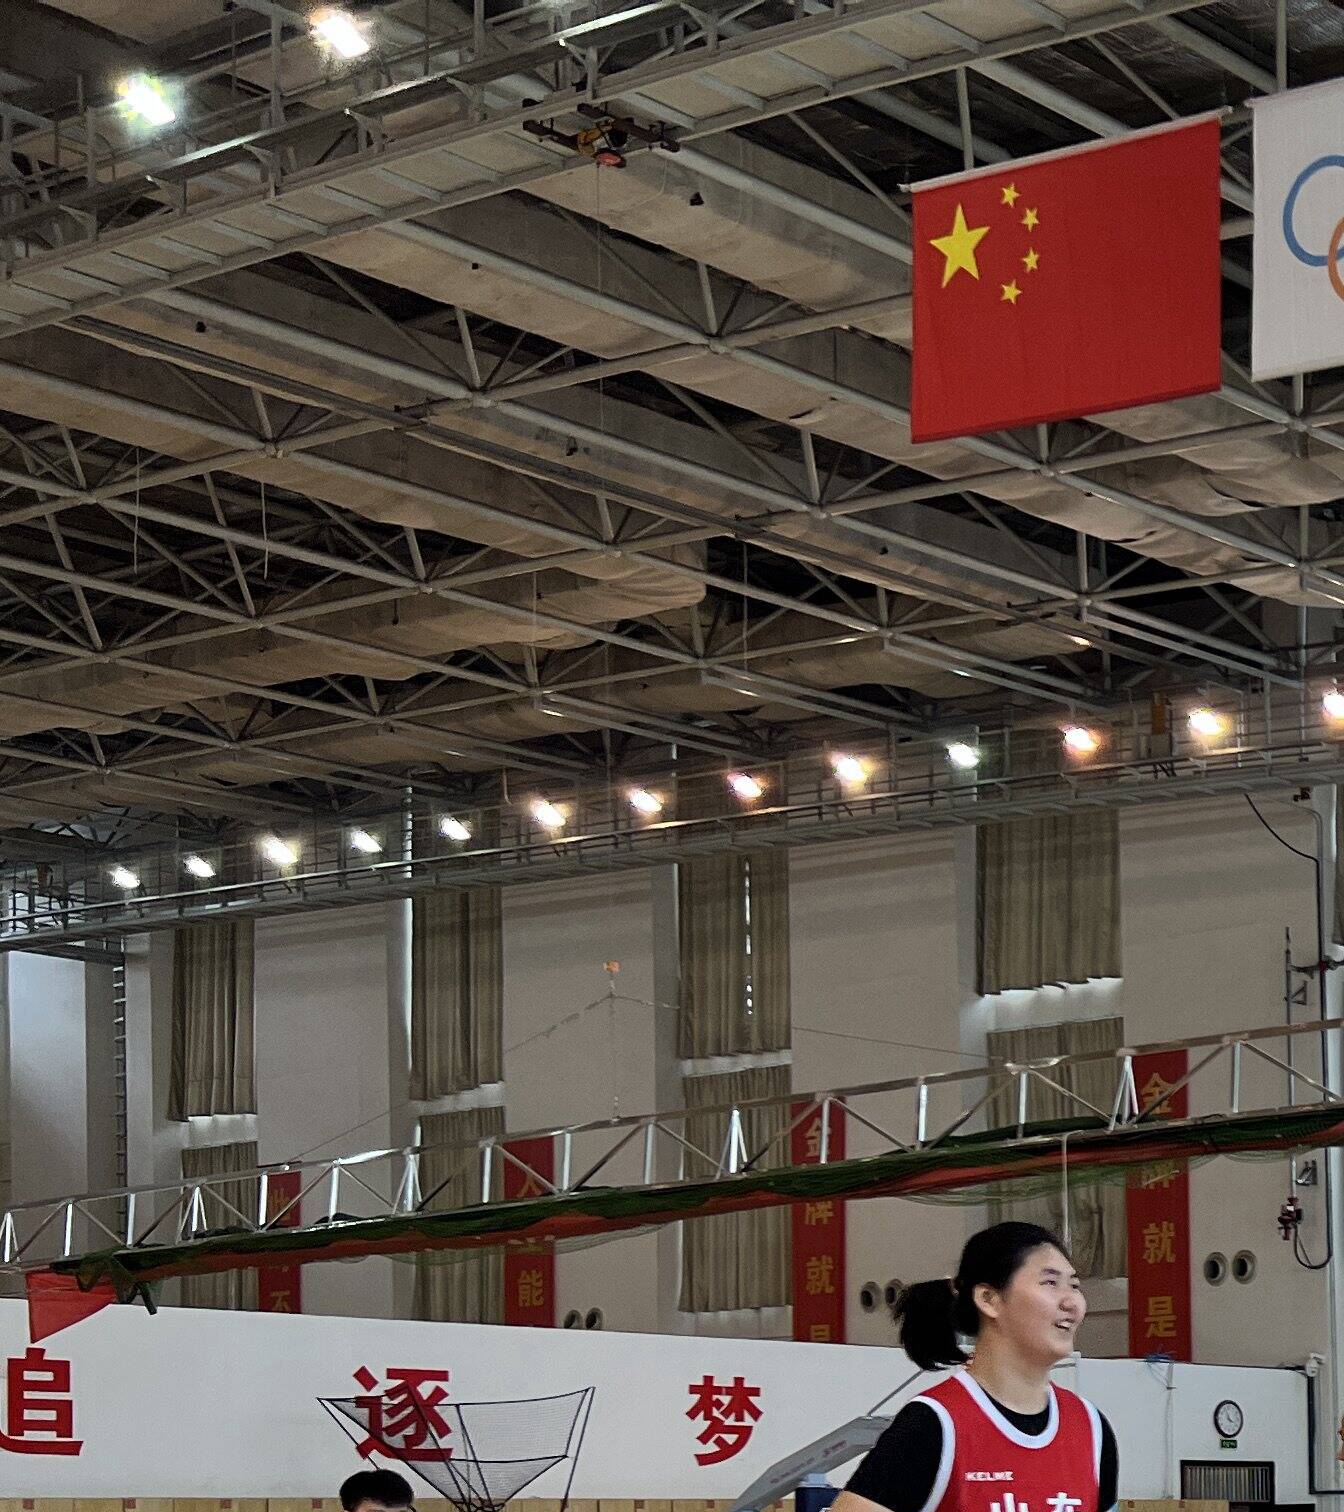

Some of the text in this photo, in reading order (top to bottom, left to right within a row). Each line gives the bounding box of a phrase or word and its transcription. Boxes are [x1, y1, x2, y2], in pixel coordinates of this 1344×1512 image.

[0, 1347, 83, 1456] 追
[352, 1368, 453, 1463] 逐
[686, 1375, 763, 1466] 梦
